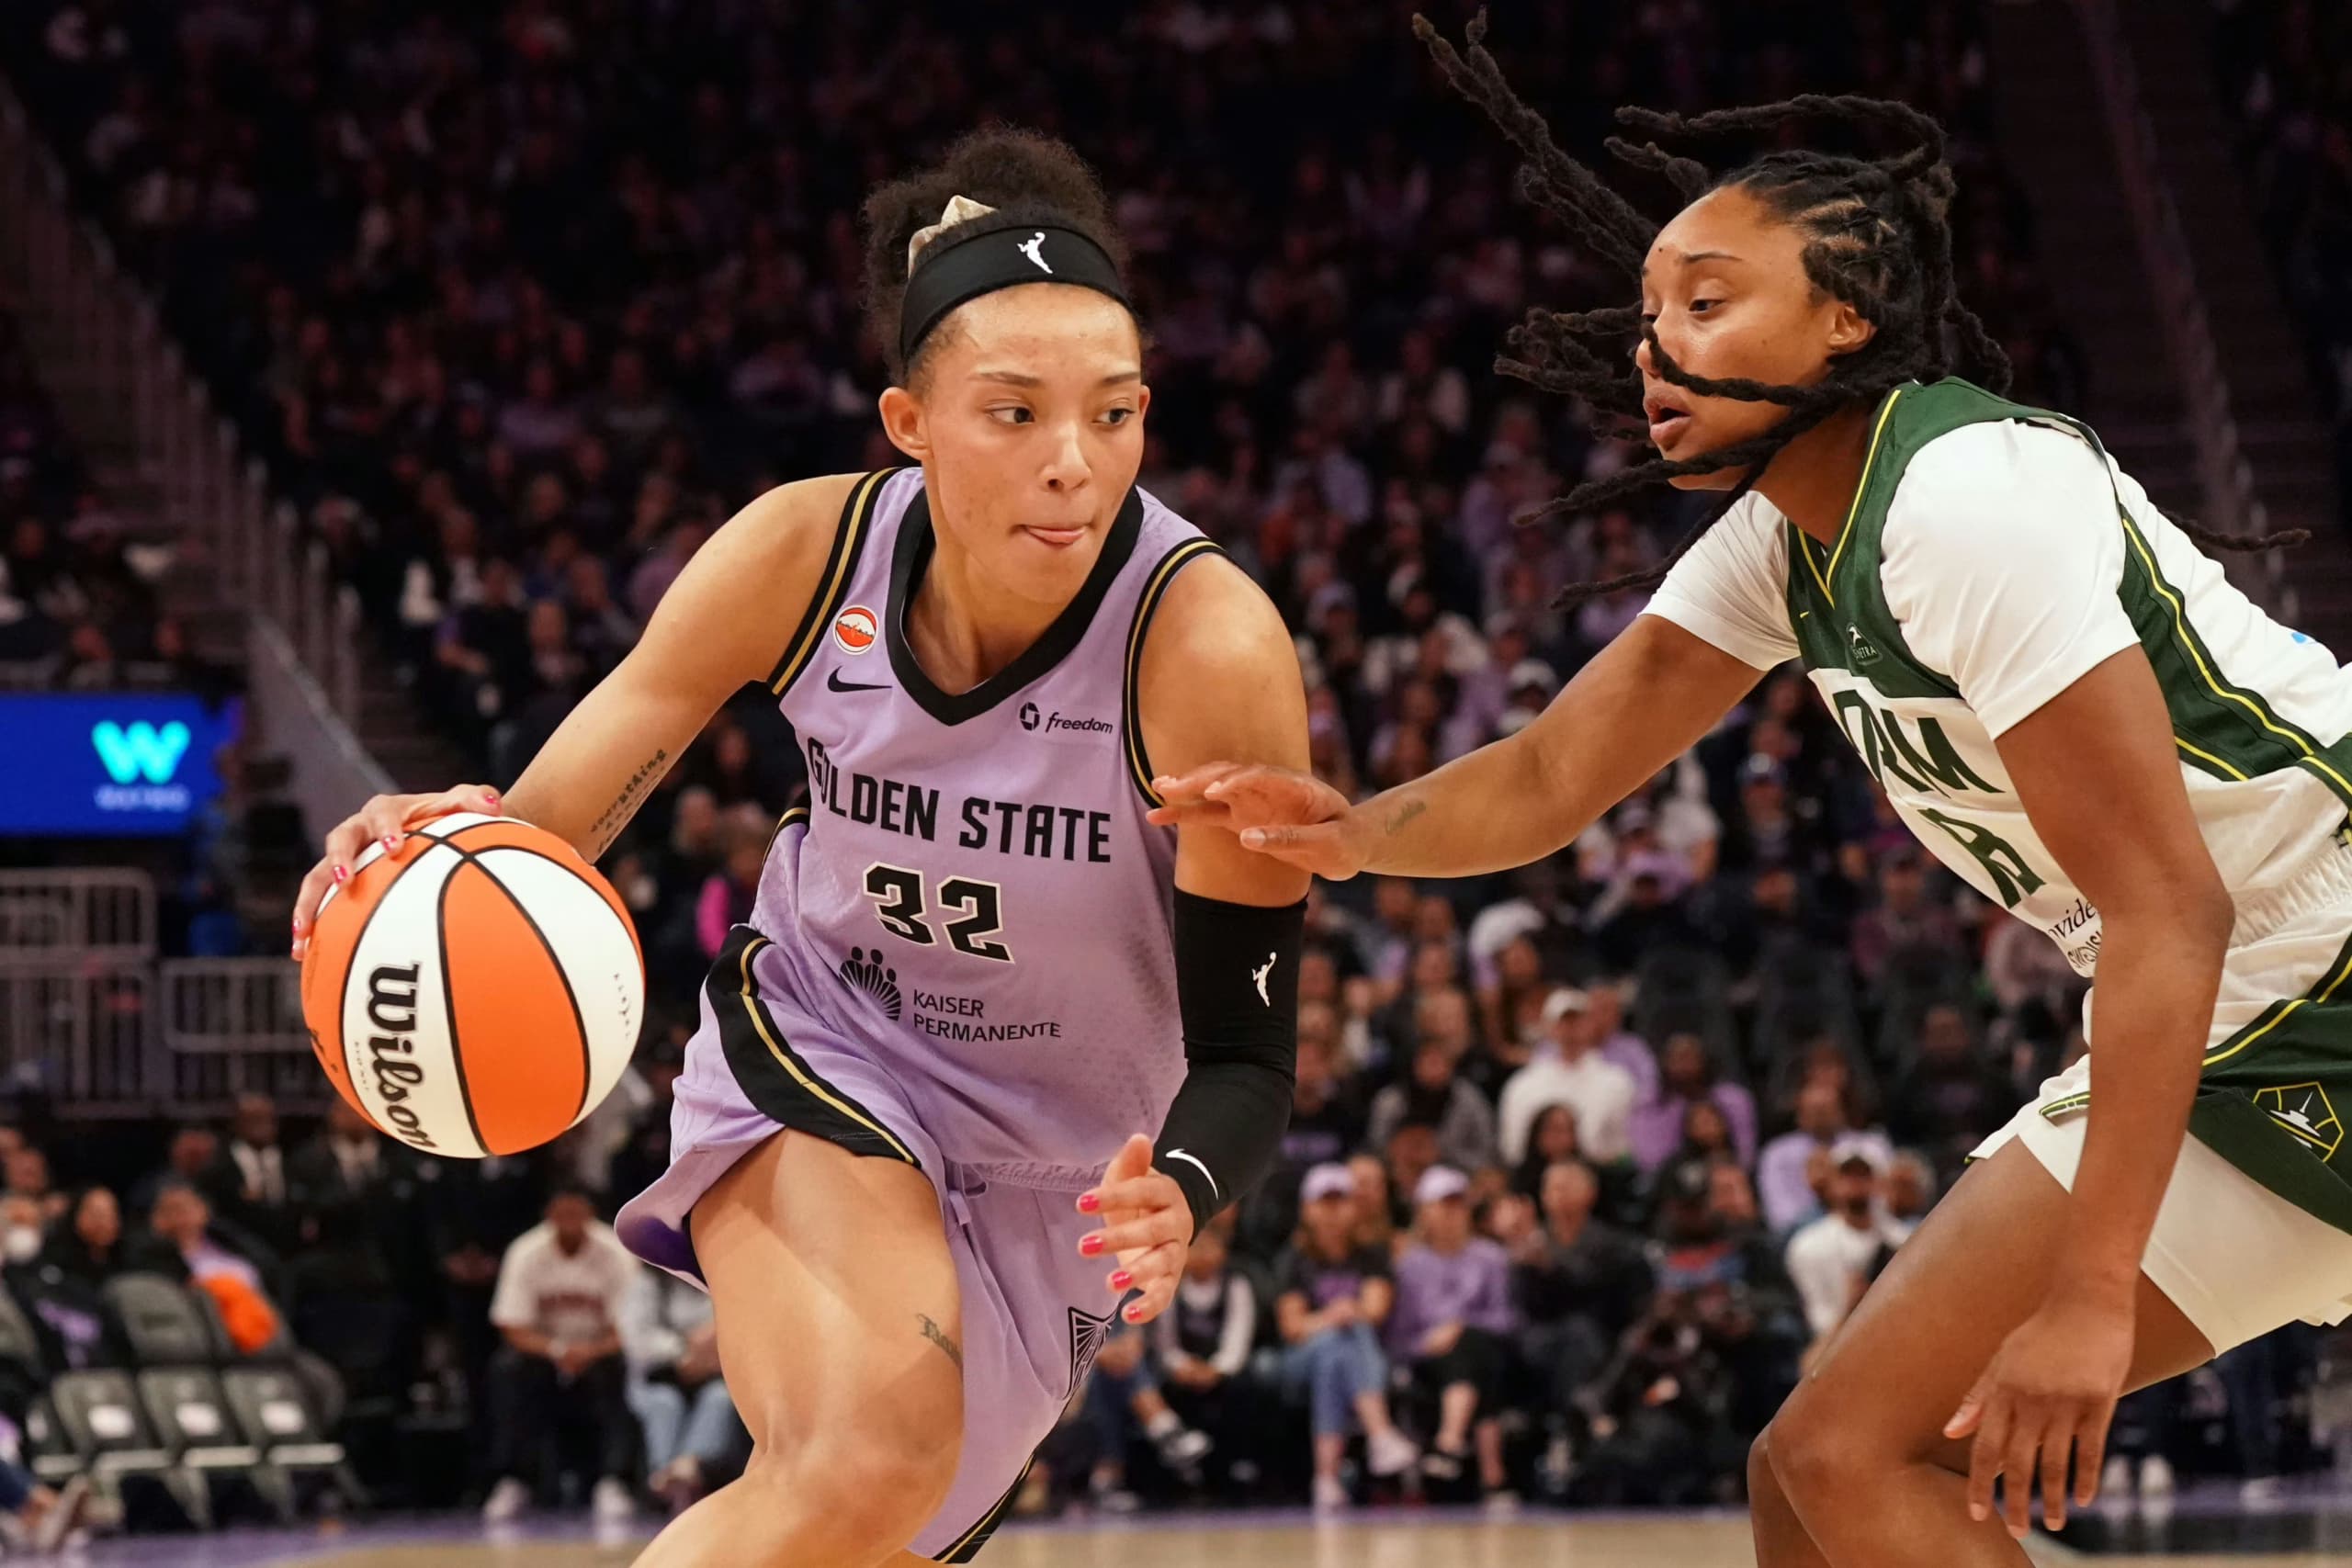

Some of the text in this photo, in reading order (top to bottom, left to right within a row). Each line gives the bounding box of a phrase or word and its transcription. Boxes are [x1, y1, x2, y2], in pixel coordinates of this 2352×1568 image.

[1045, 711, 1114, 735] freedom
[807, 736, 1111, 863] GOLDEN STATE
[862, 861, 1016, 964] 32
[912, 988, 985, 1019] KAISER
[912, 1012, 1062, 1043] PERMANENTE
[367, 960, 439, 1149] Wilson
